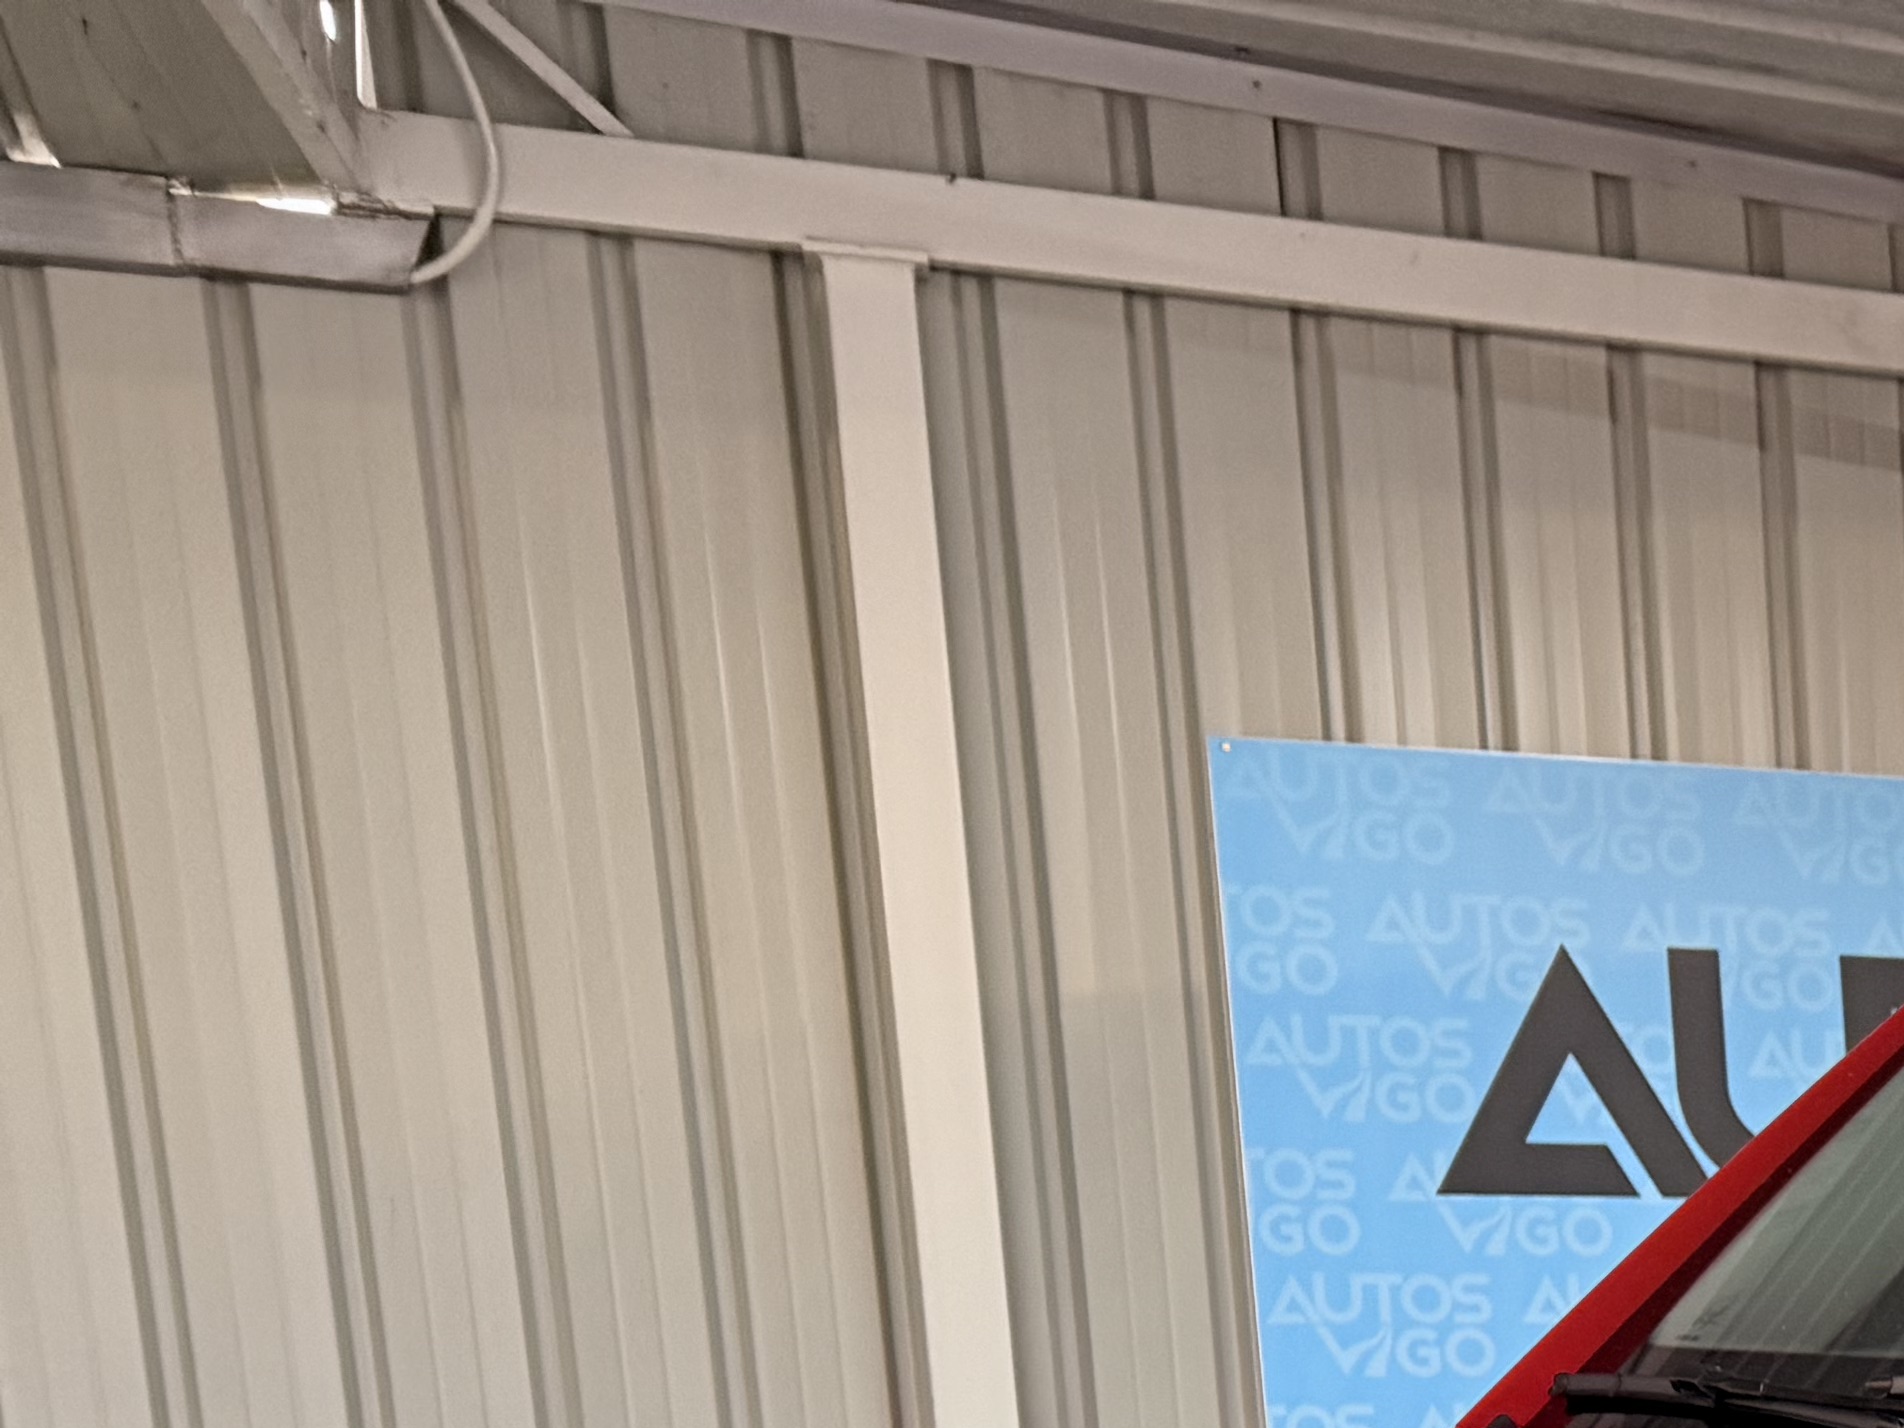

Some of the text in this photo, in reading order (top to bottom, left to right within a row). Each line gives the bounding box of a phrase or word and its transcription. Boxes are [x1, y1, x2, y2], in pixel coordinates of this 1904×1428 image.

[1224, 751, 1451, 807] AUTOS
[1482, 764, 1699, 821] AUTOS
[1367, 891, 1591, 949] AUTOS
[1247, 1013, 1473, 1069] AUTOS
[1294, 1065, 1476, 1123] VIGO
[1267, 1272, 1493, 1325] AUTOS
[1313, 1320, 1497, 1378] VIGO
